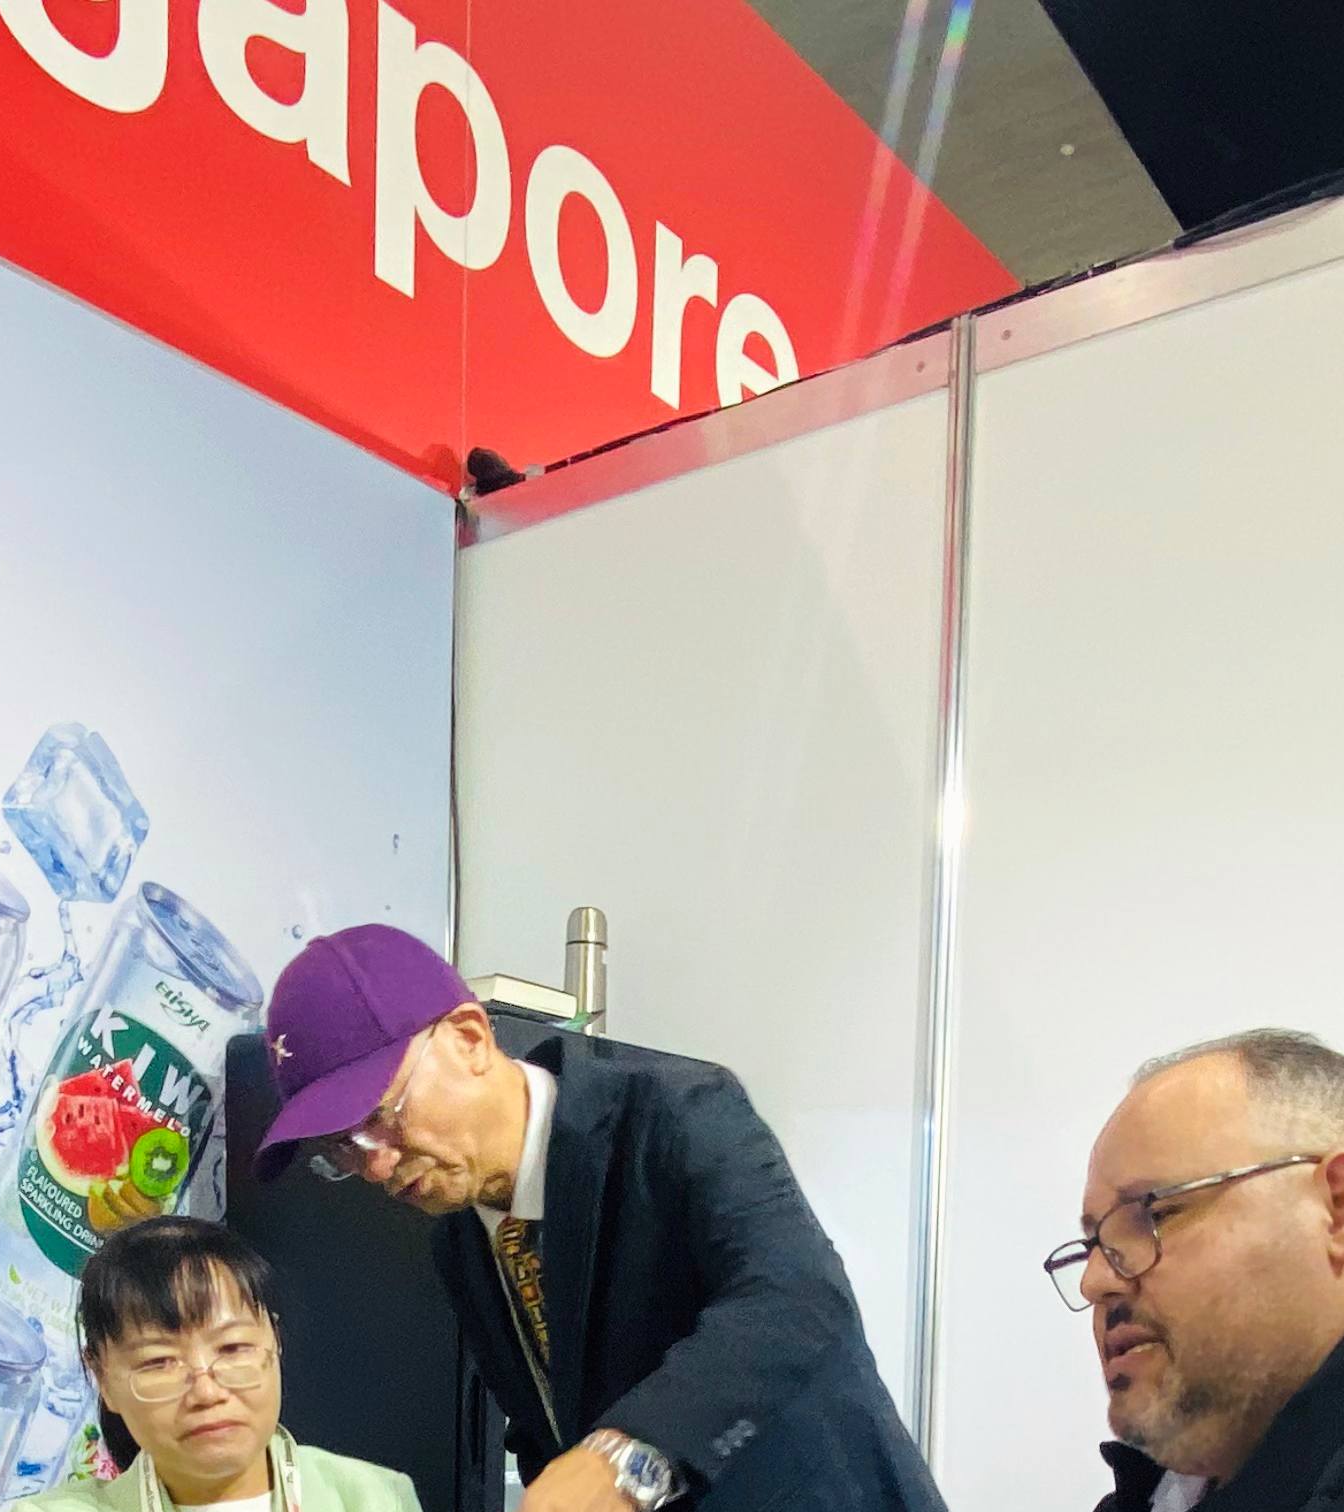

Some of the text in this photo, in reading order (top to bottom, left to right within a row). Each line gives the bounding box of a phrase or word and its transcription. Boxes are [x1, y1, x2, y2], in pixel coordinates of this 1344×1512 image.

[78, 1036, 192, 1138] WATERMELO
[19, 1177, 105, 1249] SPARKLING DRIN
[27, 1165, 83, 1219] FLAVOURED
